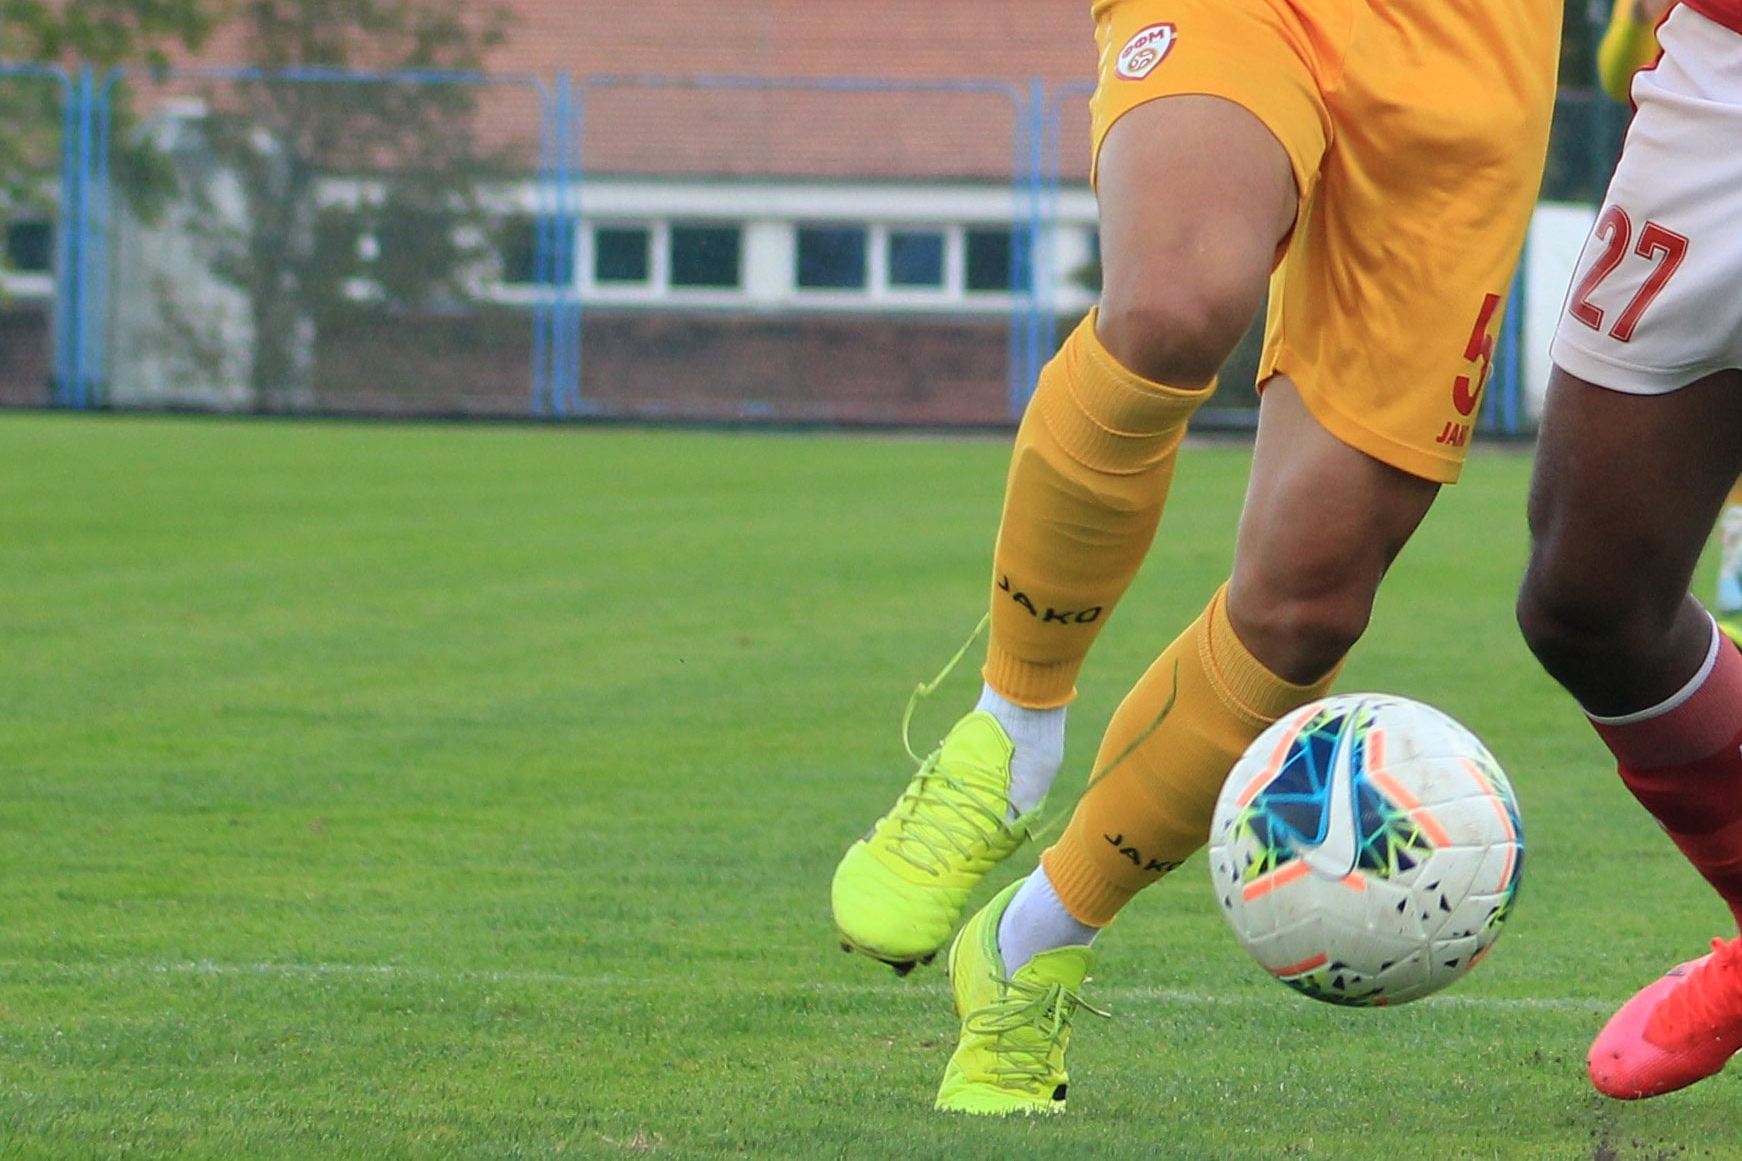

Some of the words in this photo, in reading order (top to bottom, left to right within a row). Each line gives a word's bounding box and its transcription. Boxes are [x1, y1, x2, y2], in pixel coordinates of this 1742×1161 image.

[1569, 205, 1689, 342] 27
[1453, 293, 1500, 416] 5
[998, 575, 1102, 624] JAKO
